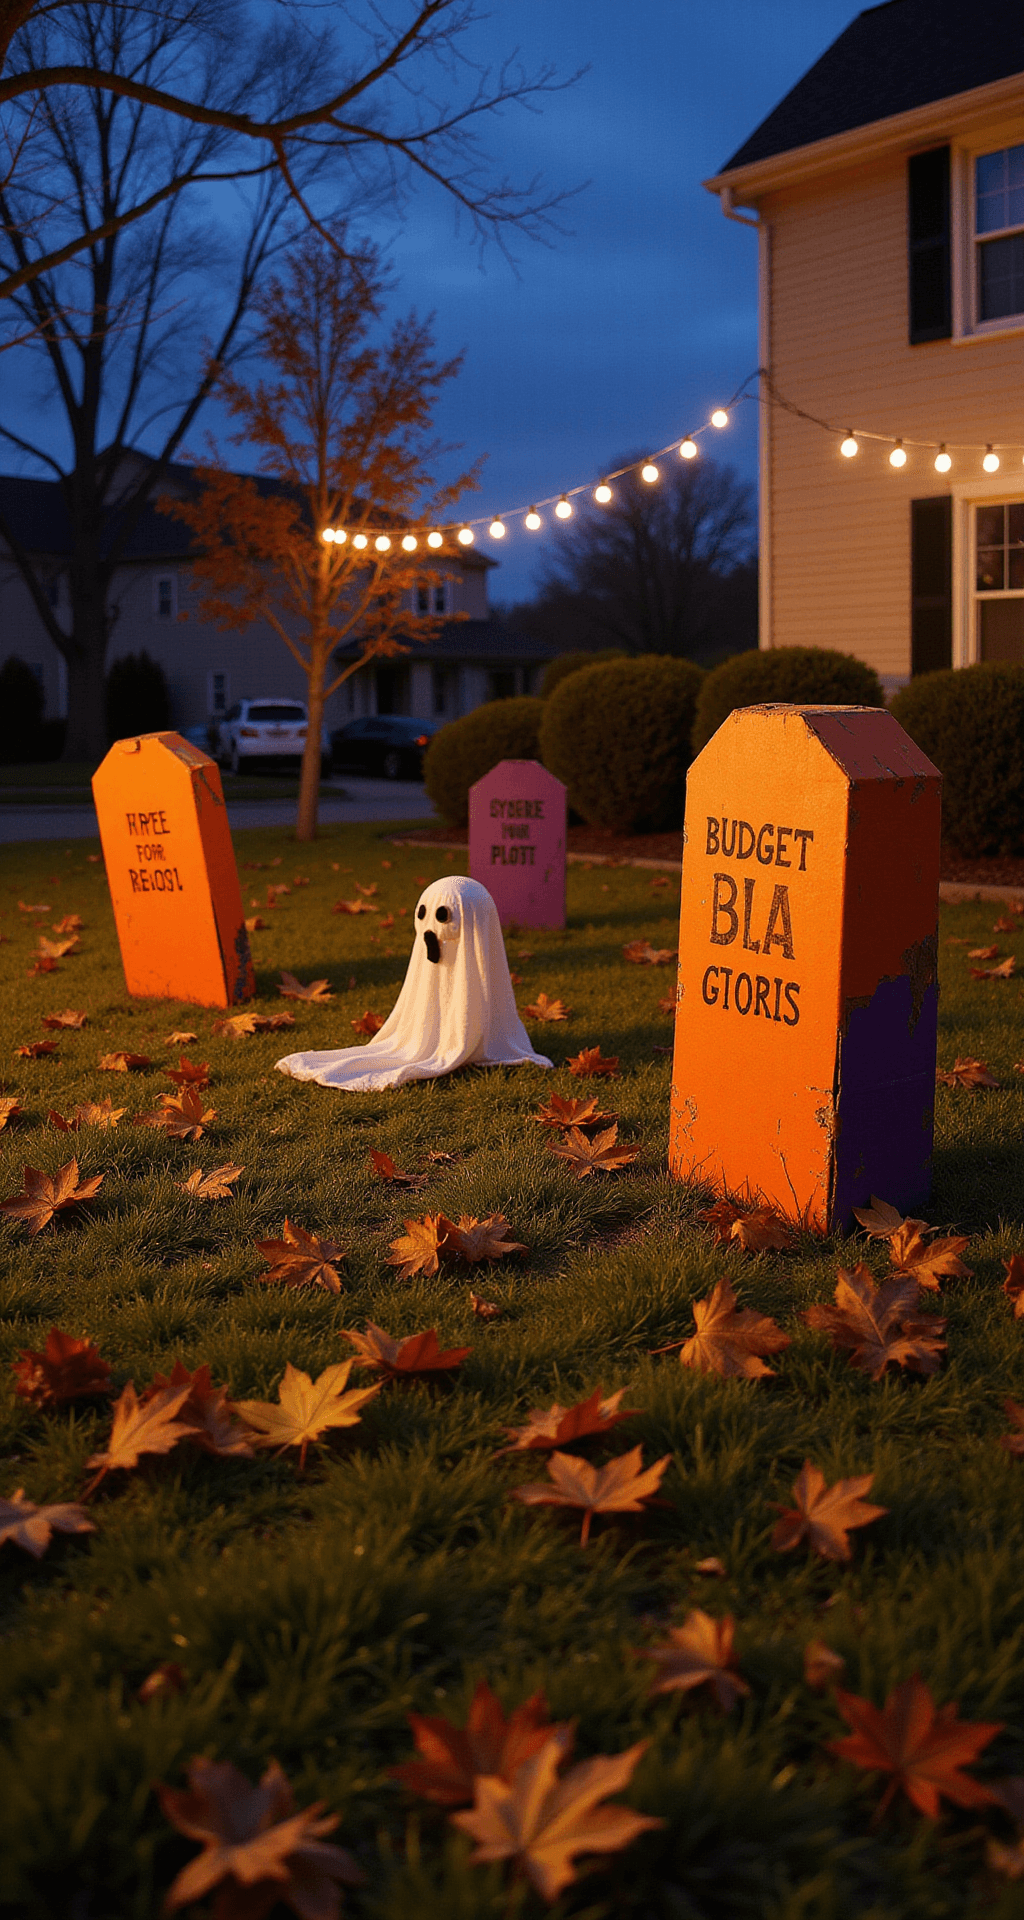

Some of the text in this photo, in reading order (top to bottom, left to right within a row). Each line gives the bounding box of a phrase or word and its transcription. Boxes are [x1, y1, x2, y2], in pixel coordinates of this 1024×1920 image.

[706, 816, 814, 871] BUDGET
[710, 872, 796, 960] BLA
[702, 965, 801, 1026] GTORIS
